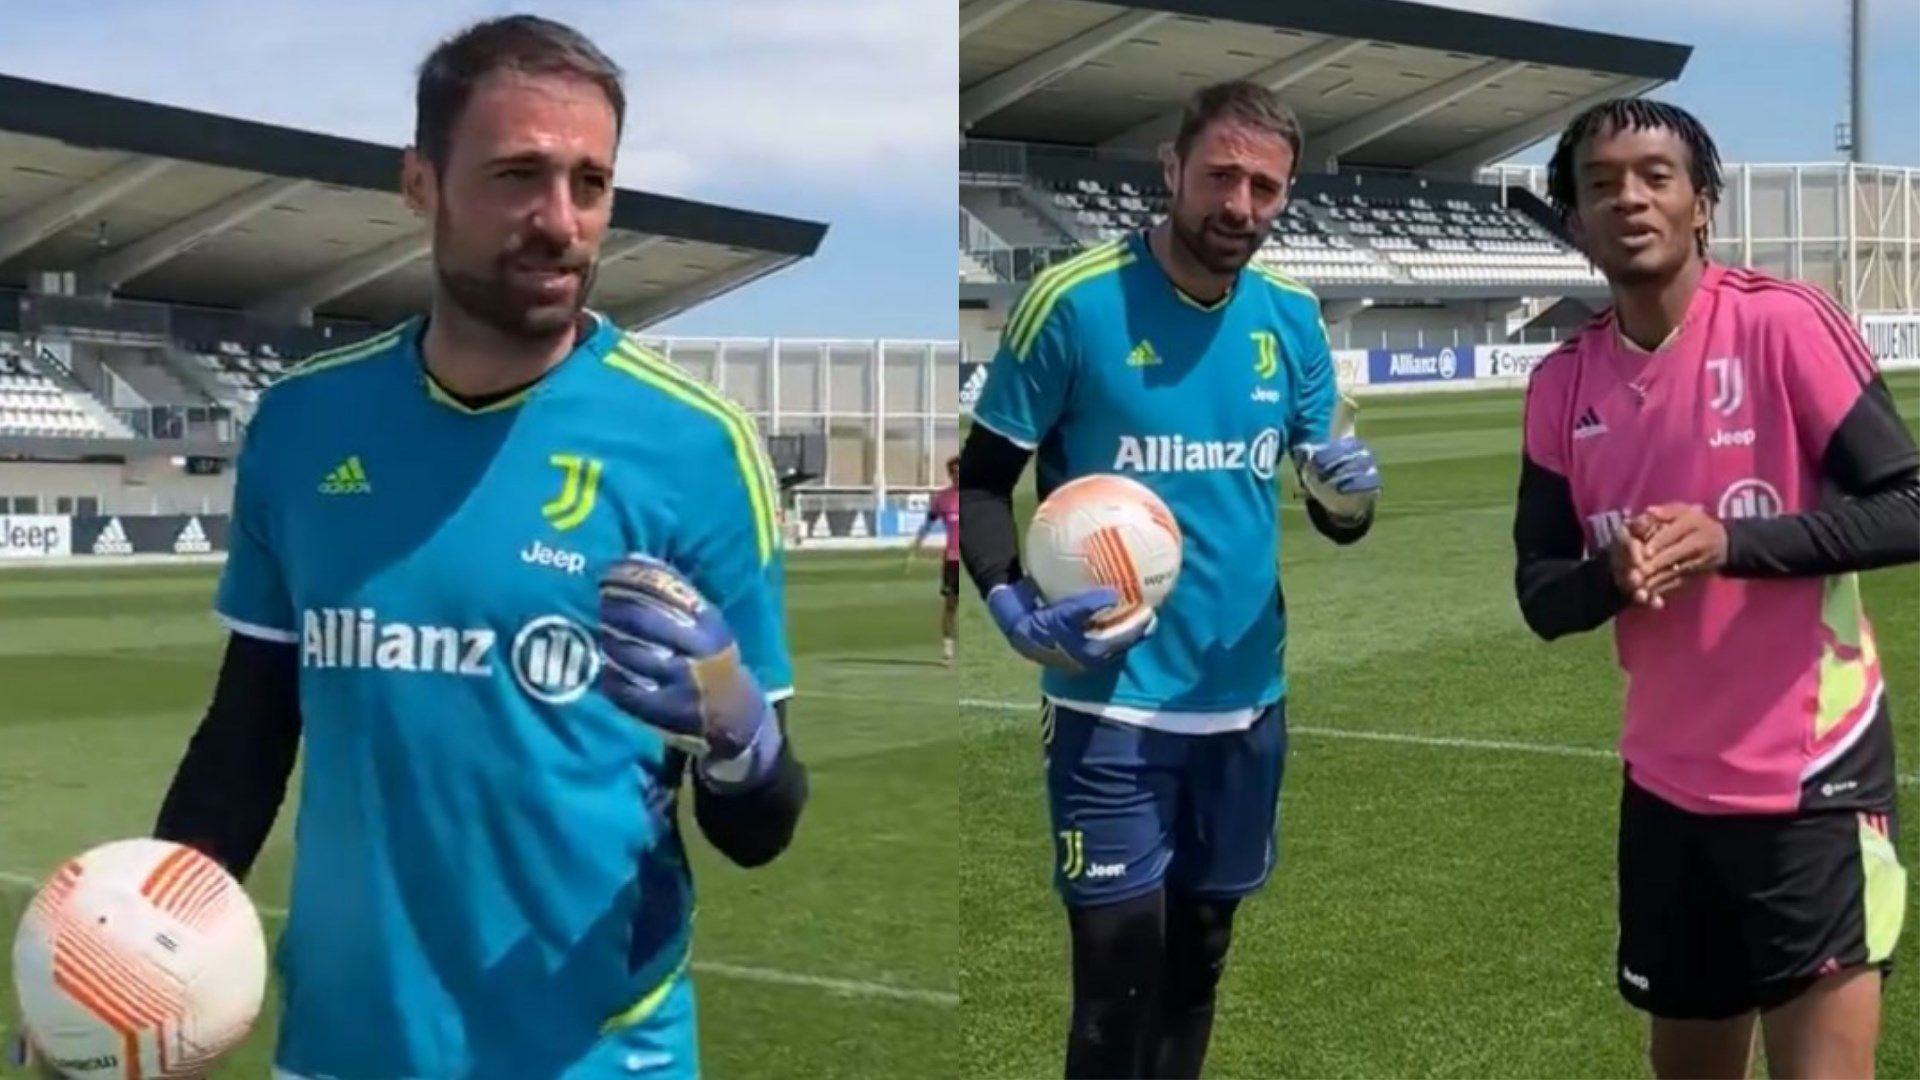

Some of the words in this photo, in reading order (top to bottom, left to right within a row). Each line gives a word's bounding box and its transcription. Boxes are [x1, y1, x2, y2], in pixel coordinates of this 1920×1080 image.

[1390, 353, 1437, 376] Allianz
[1251, 386, 1280, 404] Jeep
[1113, 435, 1246, 472] Allianz
[1709, 428, 1756, 447] Jeep
[0, 519, 60, 554] Jeep
[520, 540, 587, 575] Jeep
[303, 607, 497, 677] Allianz
